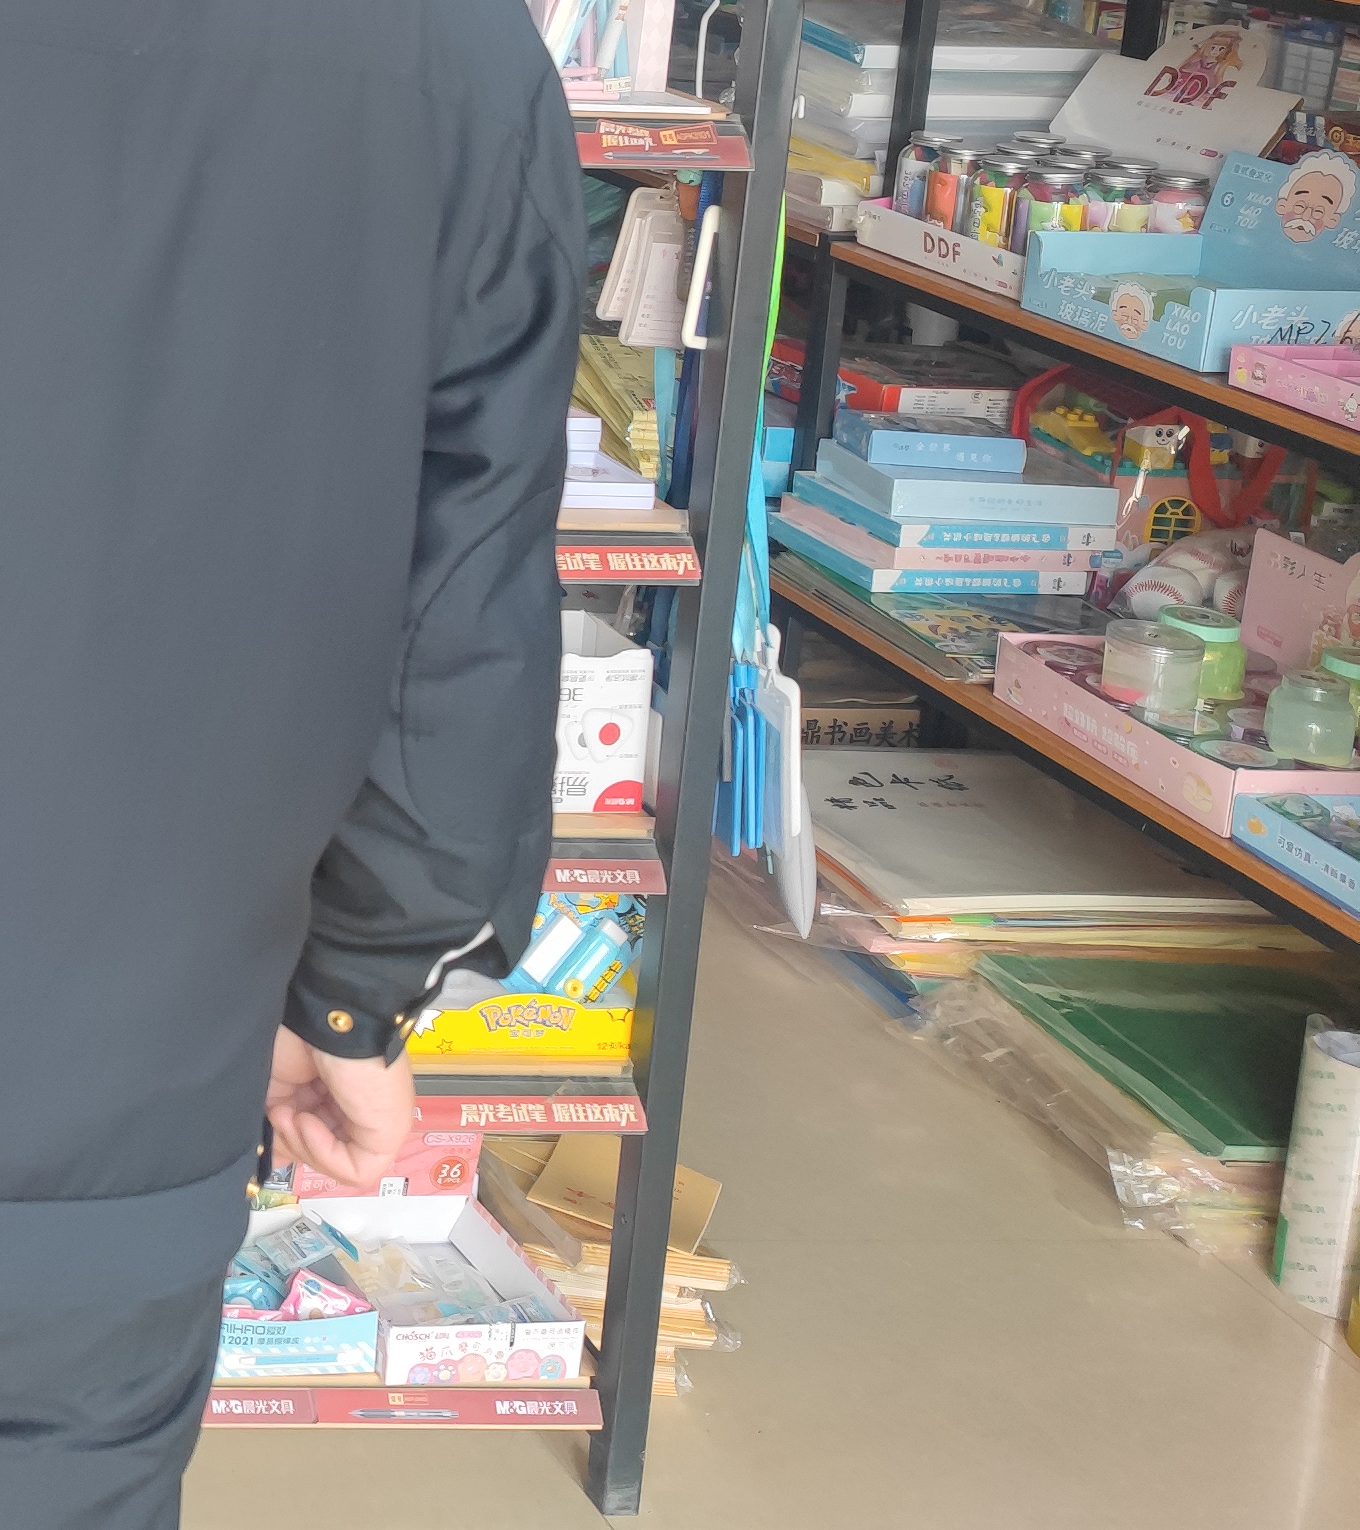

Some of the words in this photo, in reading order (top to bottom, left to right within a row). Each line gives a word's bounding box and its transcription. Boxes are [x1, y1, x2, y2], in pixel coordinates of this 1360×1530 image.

[1246, 191, 1274, 206] XIAO
[1239, 205, 1263, 217] LAO
[1233, 215, 1259, 230] TOU
[922, 229, 962, 266] DDF
[1040, 267, 1095, 302] 小老头
[1057, 299, 1110, 336] 玻璃泥
[1170, 303, 1202, 324] XIAO
[1164, 318, 1192, 336] LAO
[1160, 332, 1188, 351] TOU
[555, 868, 642, 885] M&G晨光文具
[459, 1102, 548, 1127] 晨光考试笔
[425, 1134, 477, 1145] CS-X926
[437, 1163, 463, 1179] 36
[210, 1398, 296, 1416] M&G晨光文具
[494, 1399, 580, 1416] M&G晨光文具
